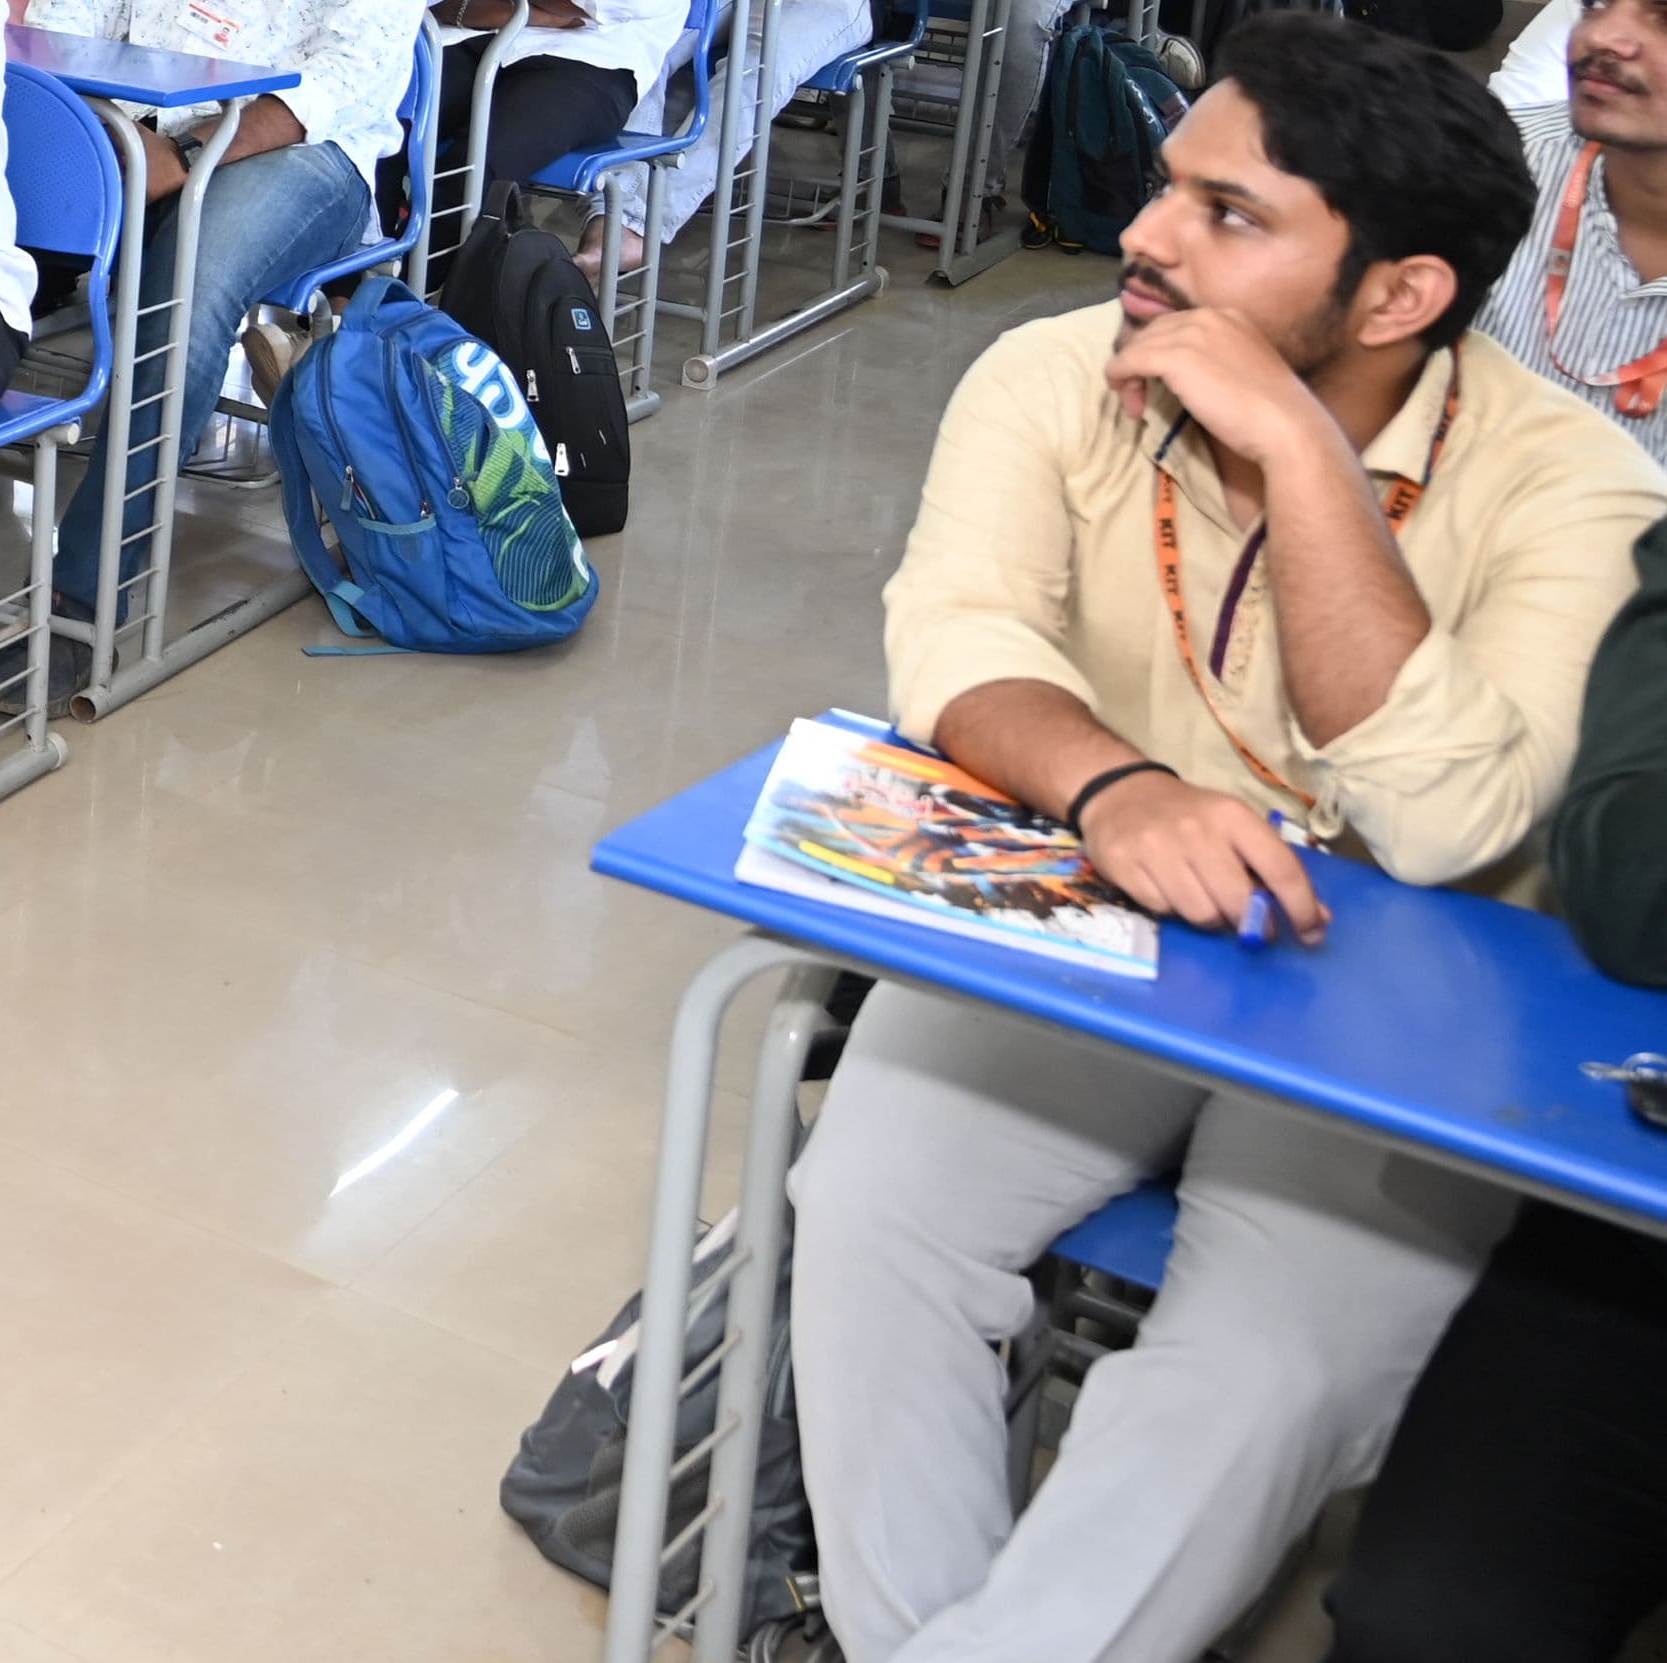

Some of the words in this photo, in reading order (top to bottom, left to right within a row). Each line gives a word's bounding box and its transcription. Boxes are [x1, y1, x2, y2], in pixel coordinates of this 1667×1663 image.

[1385, 487, 1414, 521] KIT
[1159, 518, 1177, 549] KIT
[1165, 564, 1179, 594] KIT
